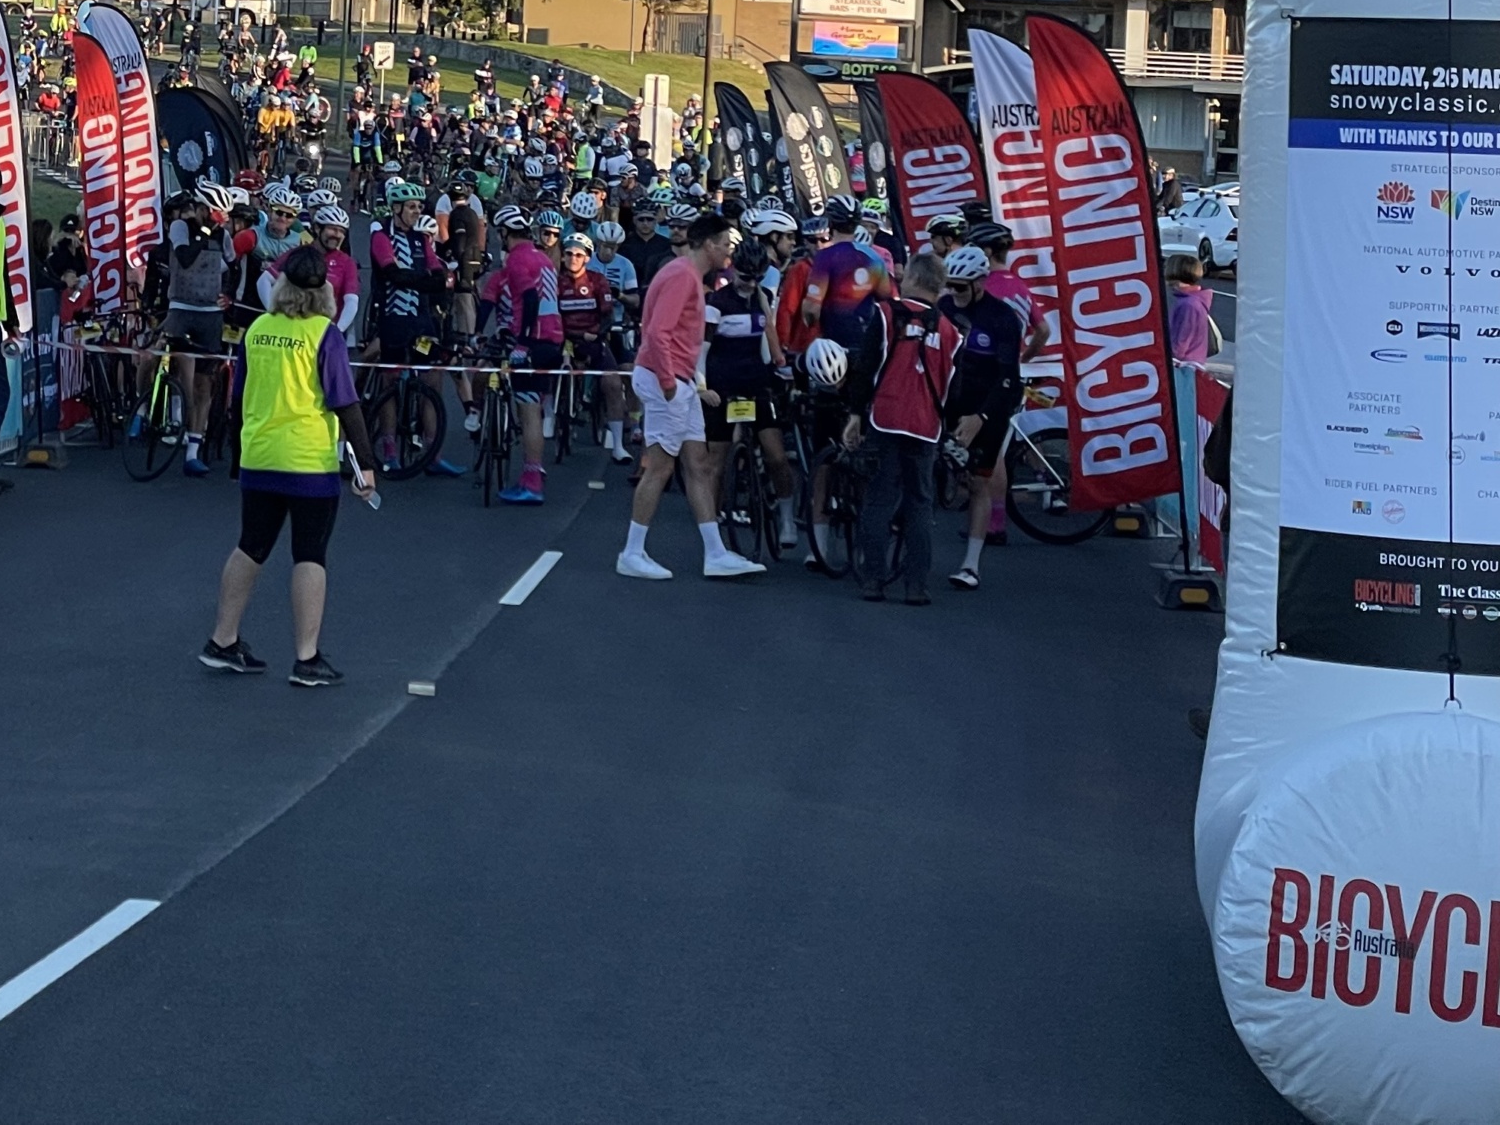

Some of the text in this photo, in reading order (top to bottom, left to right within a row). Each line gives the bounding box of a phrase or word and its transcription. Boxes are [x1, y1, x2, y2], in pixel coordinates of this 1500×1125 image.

[1330, 64, 1430, 90] SATURDAY,
[1433, 67, 1459, 88] 26
[1330, 92, 1500, 115] snowyclassic.
[1339, 127, 1376, 144] WITH
[1378, 128, 1437, 147] THANKS
[1440, 130, 1458, 147] TO
[1462, 131, 1493, 148] OUR
[1390, 163, 1448, 174] STRATEGIC
[1377, 206, 1415, 220] NSW
[1470, 206, 1495, 216] NSW
[1363, 245, 1413, 256] NATIONAL
[1417, 248, 1485, 259] AUTOMOTIVE
[1396, 265, 1500, 278] VOLVO
[1055, 133, 1169, 477] BICYCLING
[1388, 301, 1500, 315] SUPPORTING PARTNE
[277, 336, 306, 351] STAFF
[1347, 391, 1402, 404] ASSOCIATE
[1348, 403, 1401, 416] PARTNERS
[1325, 478, 1438, 496] RIDER FUEL PARTNERS
[1352, 506, 1372, 515] KIND
[1379, 553, 1499, 572] BROUGHT TO YOU
[1354, 578, 1415, 607] BICYCLING
[1438, 584, 1500, 599] The Class
[1265, 867, 1500, 1029] BICYCL
[1354, 928, 1416, 961] Australia
